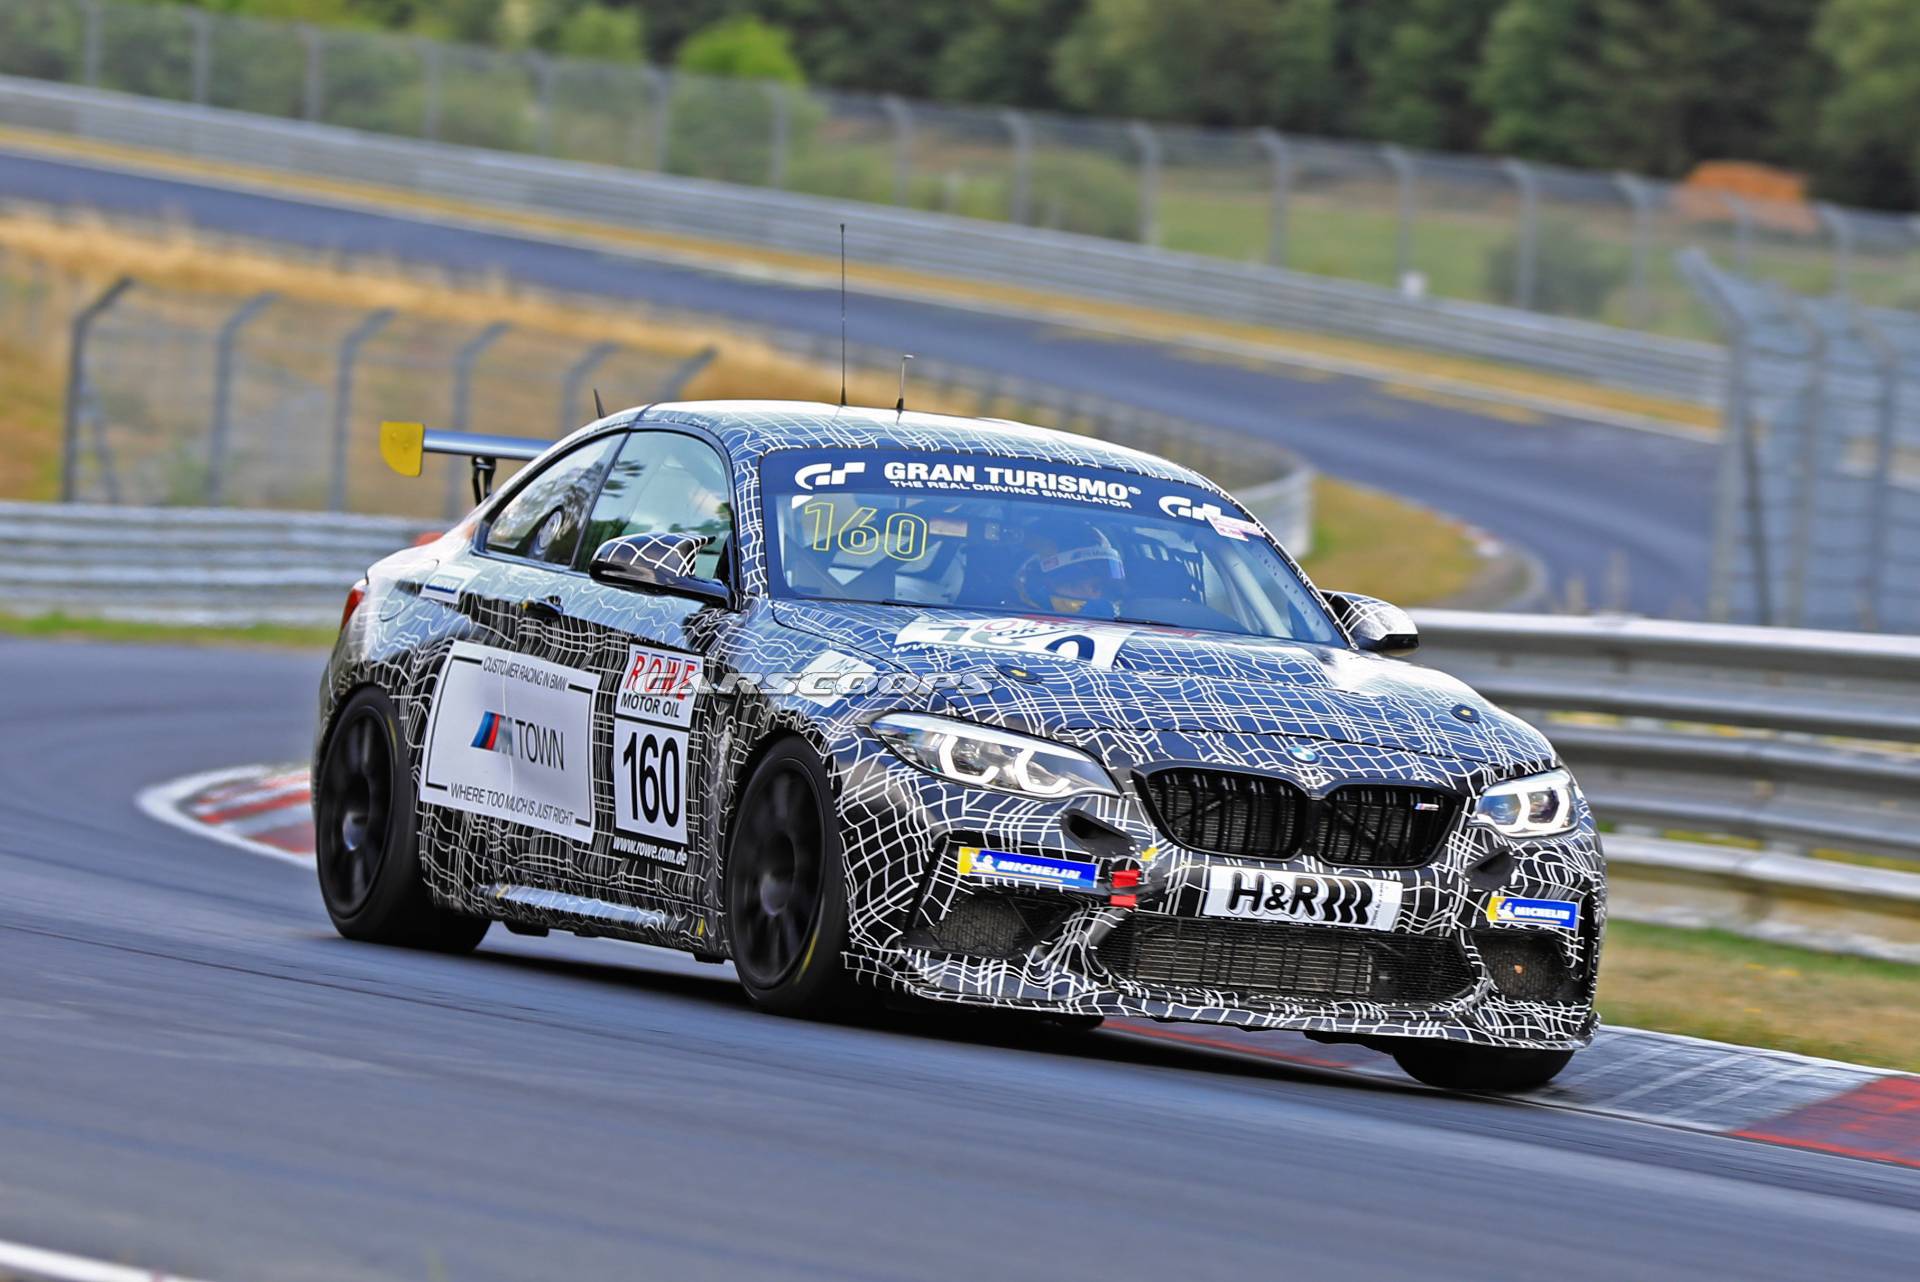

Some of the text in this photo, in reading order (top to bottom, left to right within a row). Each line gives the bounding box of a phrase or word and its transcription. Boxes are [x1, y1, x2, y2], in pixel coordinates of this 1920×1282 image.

[884, 461, 976, 484] GRAN
[889, 480, 1132, 509] THE REAL DRIVING SIMULATOR
[804, 502, 928, 561] 160
[483, 656, 568, 692] CUSTOMER RACING IN BMW
[625, 653, 697, 701] ROWE
[620, 692, 680, 718] MOTOR OIL
[515, 719, 564, 771] TOWN
[623, 731, 681, 828] 160
[450, 783, 575, 826] WHERE TOO MUCH IS JUST RIGHT
[613, 836, 688, 866] www.rowe.com.de
[997, 860, 1082, 880] MICHELIN
[1227, 871, 1322, 922] H&R
